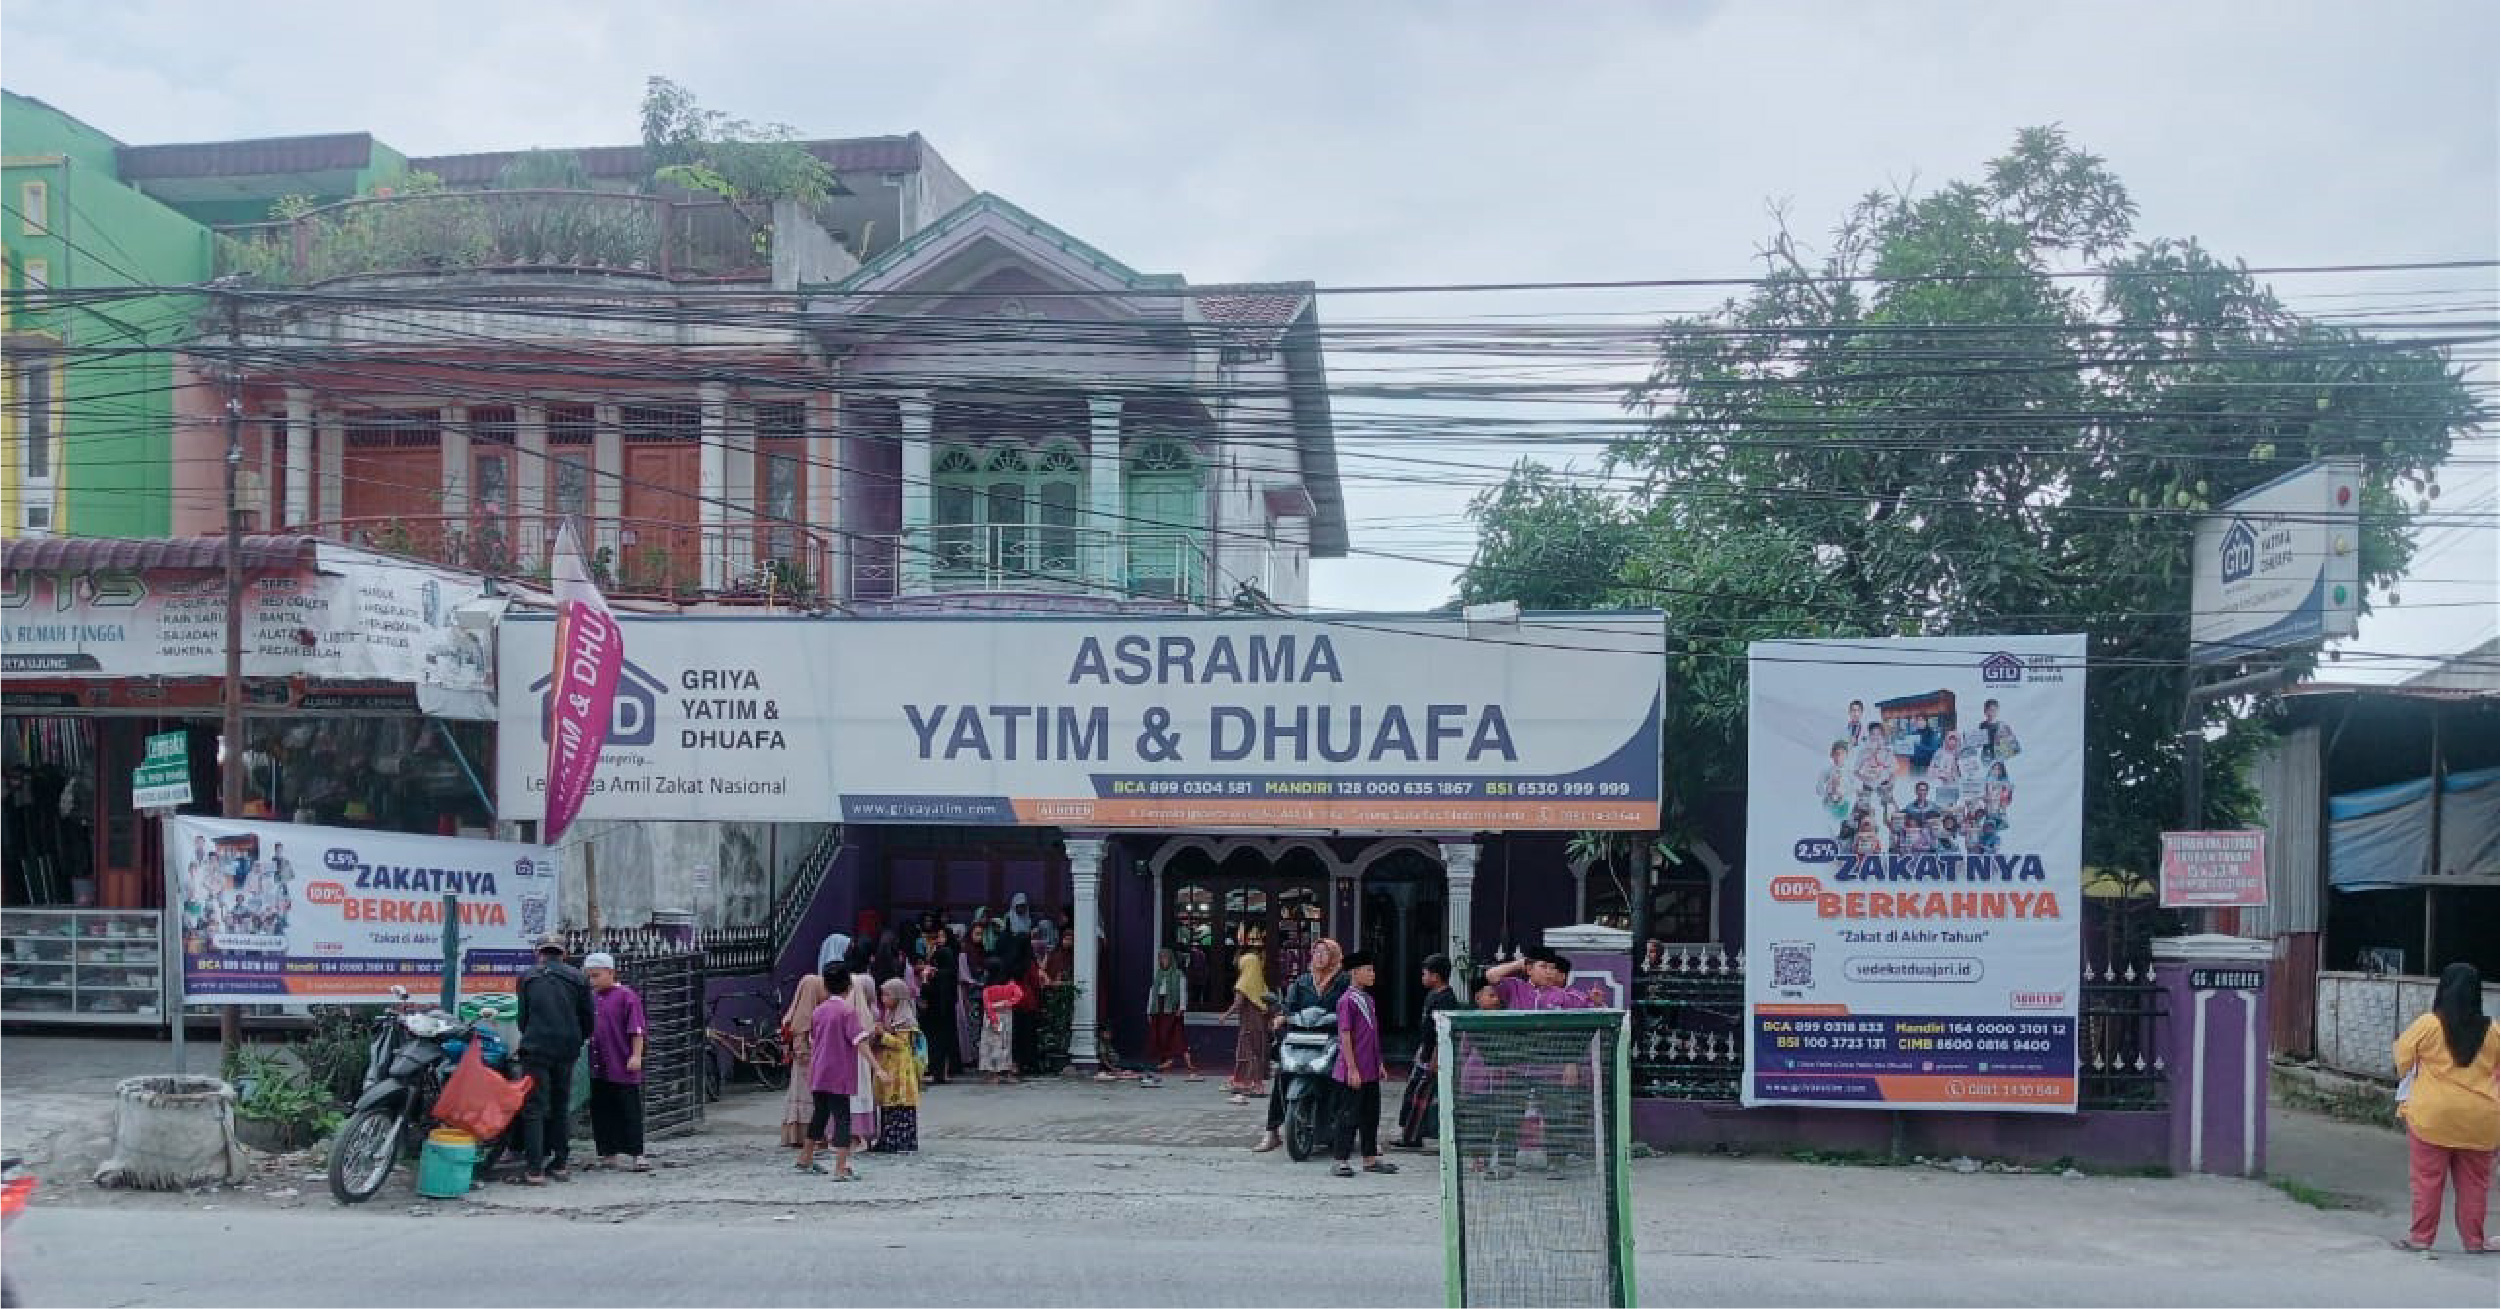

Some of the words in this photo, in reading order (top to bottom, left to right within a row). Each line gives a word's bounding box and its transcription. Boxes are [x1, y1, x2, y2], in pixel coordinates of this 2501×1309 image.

[17, 624, 66, 641] RUMAH
[1068, 634, 1344, 685] ASRAMA
[681, 669, 760, 690] GRIYA
[681, 699, 758, 720] YATIM
[763, 699, 780, 720] &
[681, 730, 786, 750] DHUAFA
[903, 704, 1109, 761] YATIM
[1136, 705, 1183, 762] &
[1210, 704, 1518, 762] DHUAFA
[610, 776, 650, 793] Amil
[655, 776, 703, 794] Zakat
[710, 776, 787, 794] Nasional
[1114, 780, 1146, 794] BCA
[1265, 781, 1333, 794] MANDIRI
[1486, 782, 1513, 795] BSI
[853, 802, 997, 816] www.griyayatim.com
[1834, 854, 2046, 882] ZAKATNYA
[355, 864, 498, 895] ZAKATNYA
[1773, 881, 1817, 897] 100%
[1816, 892, 2062, 919] BERKAHNYA
[1901, 930, 1938, 943] Akhir
[1763, 1021, 1792, 1032] BCA
[1976, 1024, 2015, 1034] 0000
[1804, 1037, 1828, 1048] 100
[1898, 1038, 1933, 1050] CIMB
